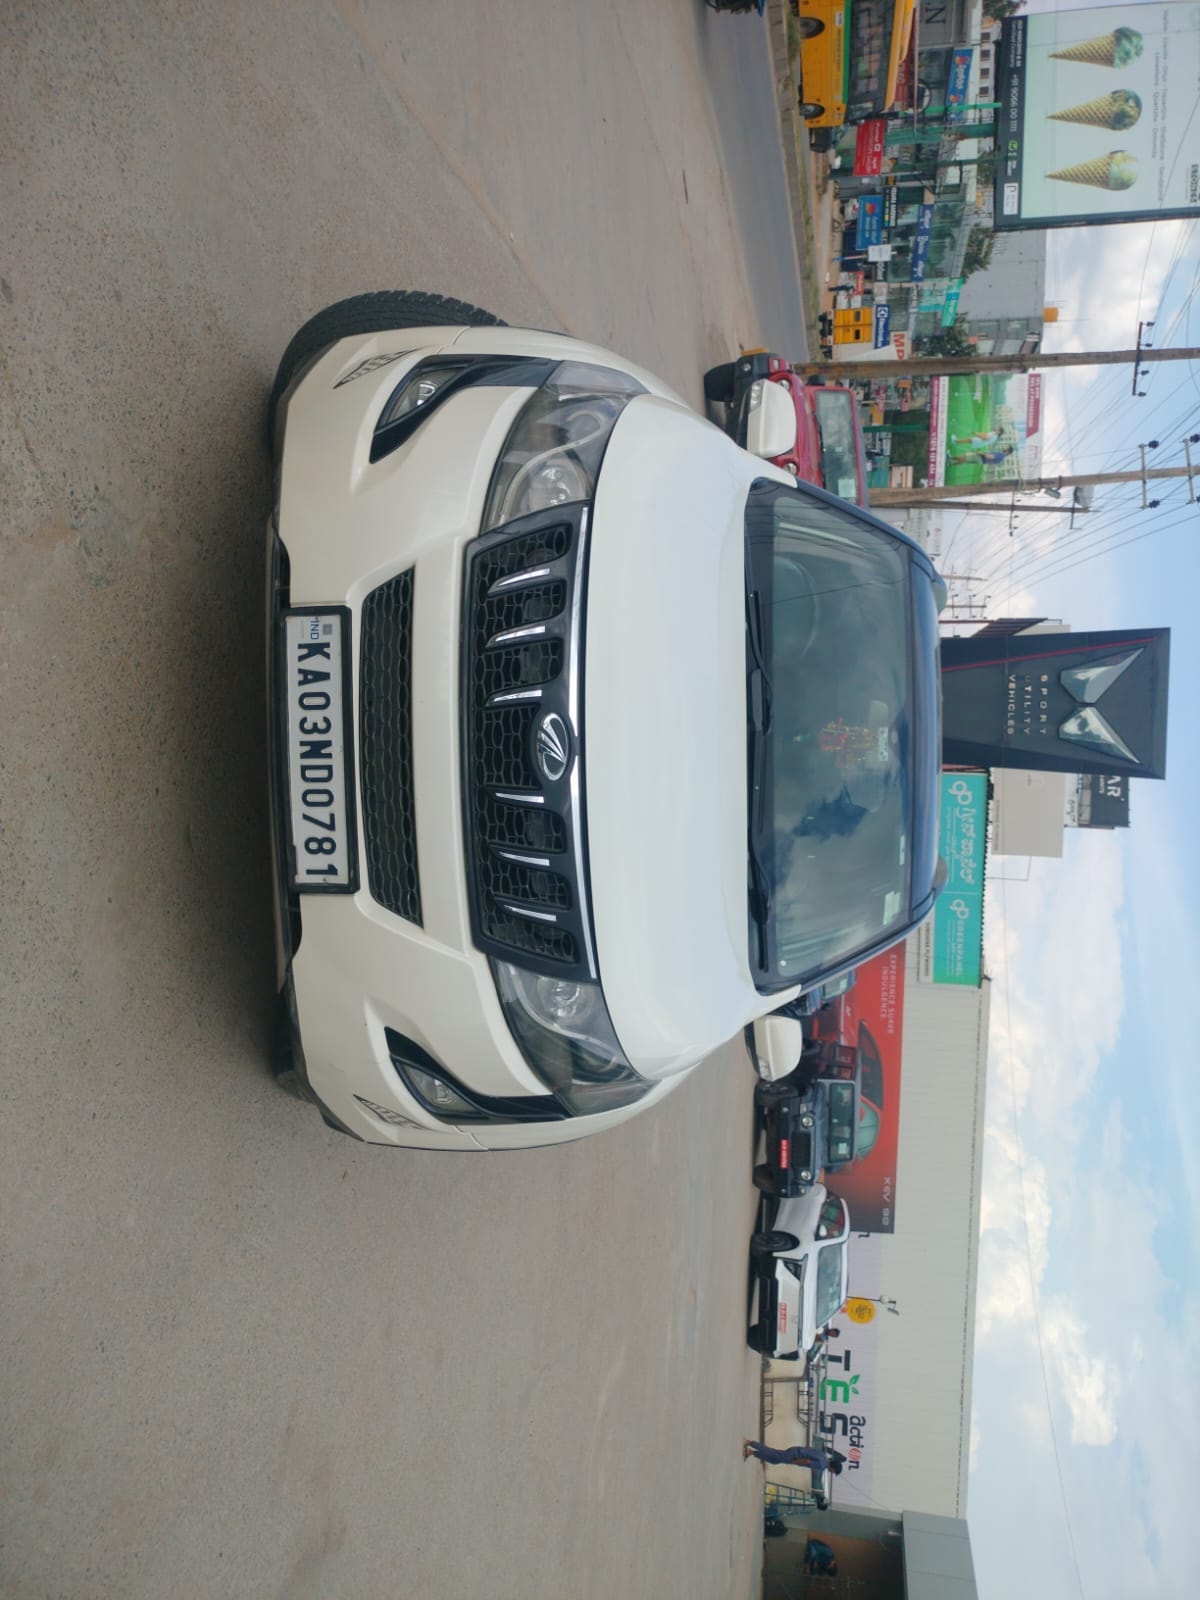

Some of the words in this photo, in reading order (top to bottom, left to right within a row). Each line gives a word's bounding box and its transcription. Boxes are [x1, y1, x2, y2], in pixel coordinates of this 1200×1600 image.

[310, 620, 320, 640] IND
[1007, 674, 1016, 735] VEHICLES
[1040, 674, 1048, 735] SPORT
[298, 642, 338, 876] KA03ND0781
[956, 920, 964, 976] GREENPANEL
[888, 954, 896, 1004] EXPERIENCE
[887, 1008, 895, 1034] SUAVE
[848, 1416, 866, 1470] action
